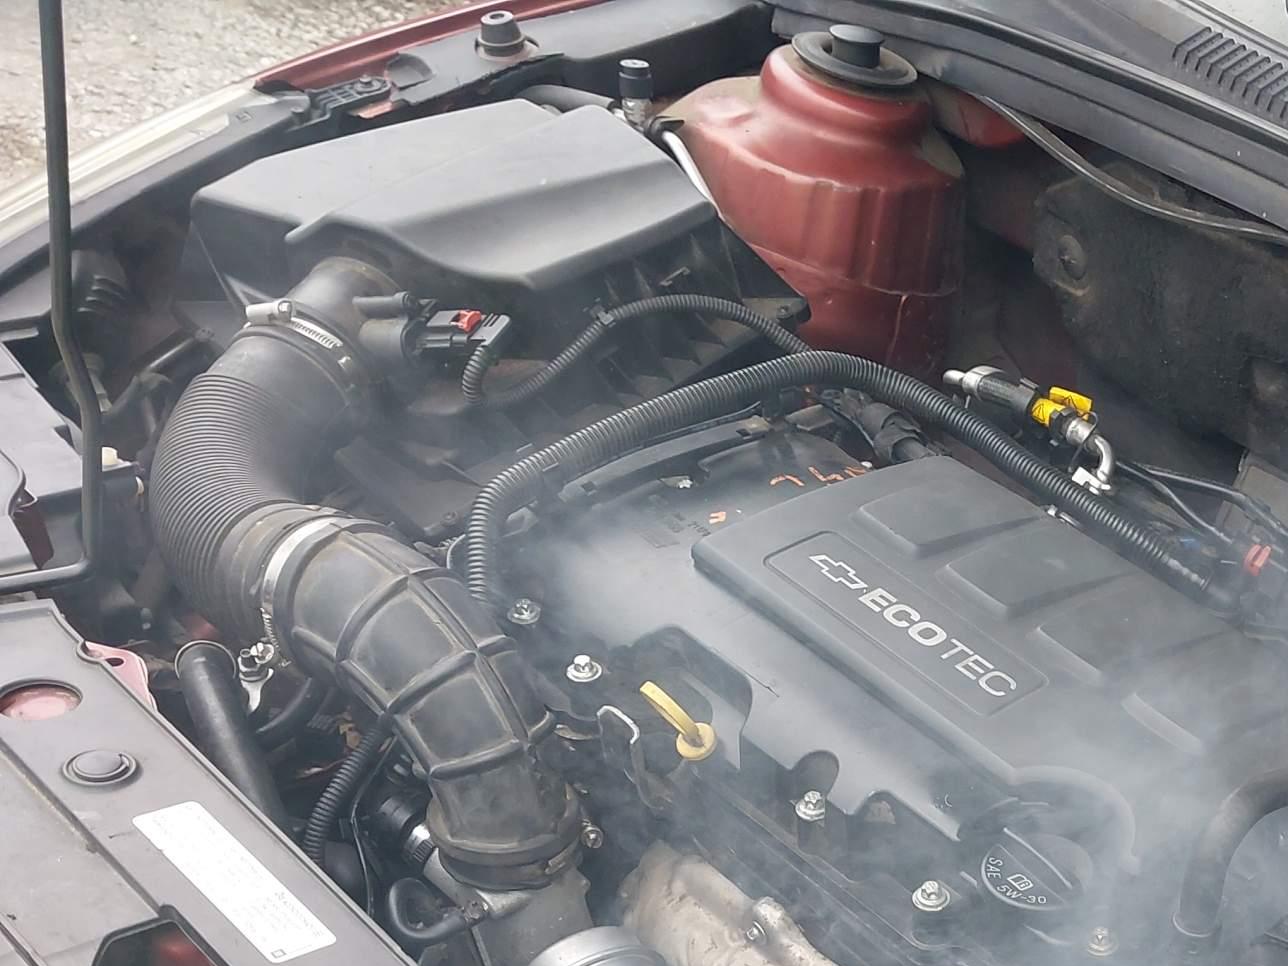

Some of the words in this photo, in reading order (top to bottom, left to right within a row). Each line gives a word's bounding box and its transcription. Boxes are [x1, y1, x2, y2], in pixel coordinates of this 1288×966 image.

[858, 588, 1017, 697] ECOTEC
[986, 857, 1004, 880] SAE
[996, 884, 1048, 905] 5W-30
